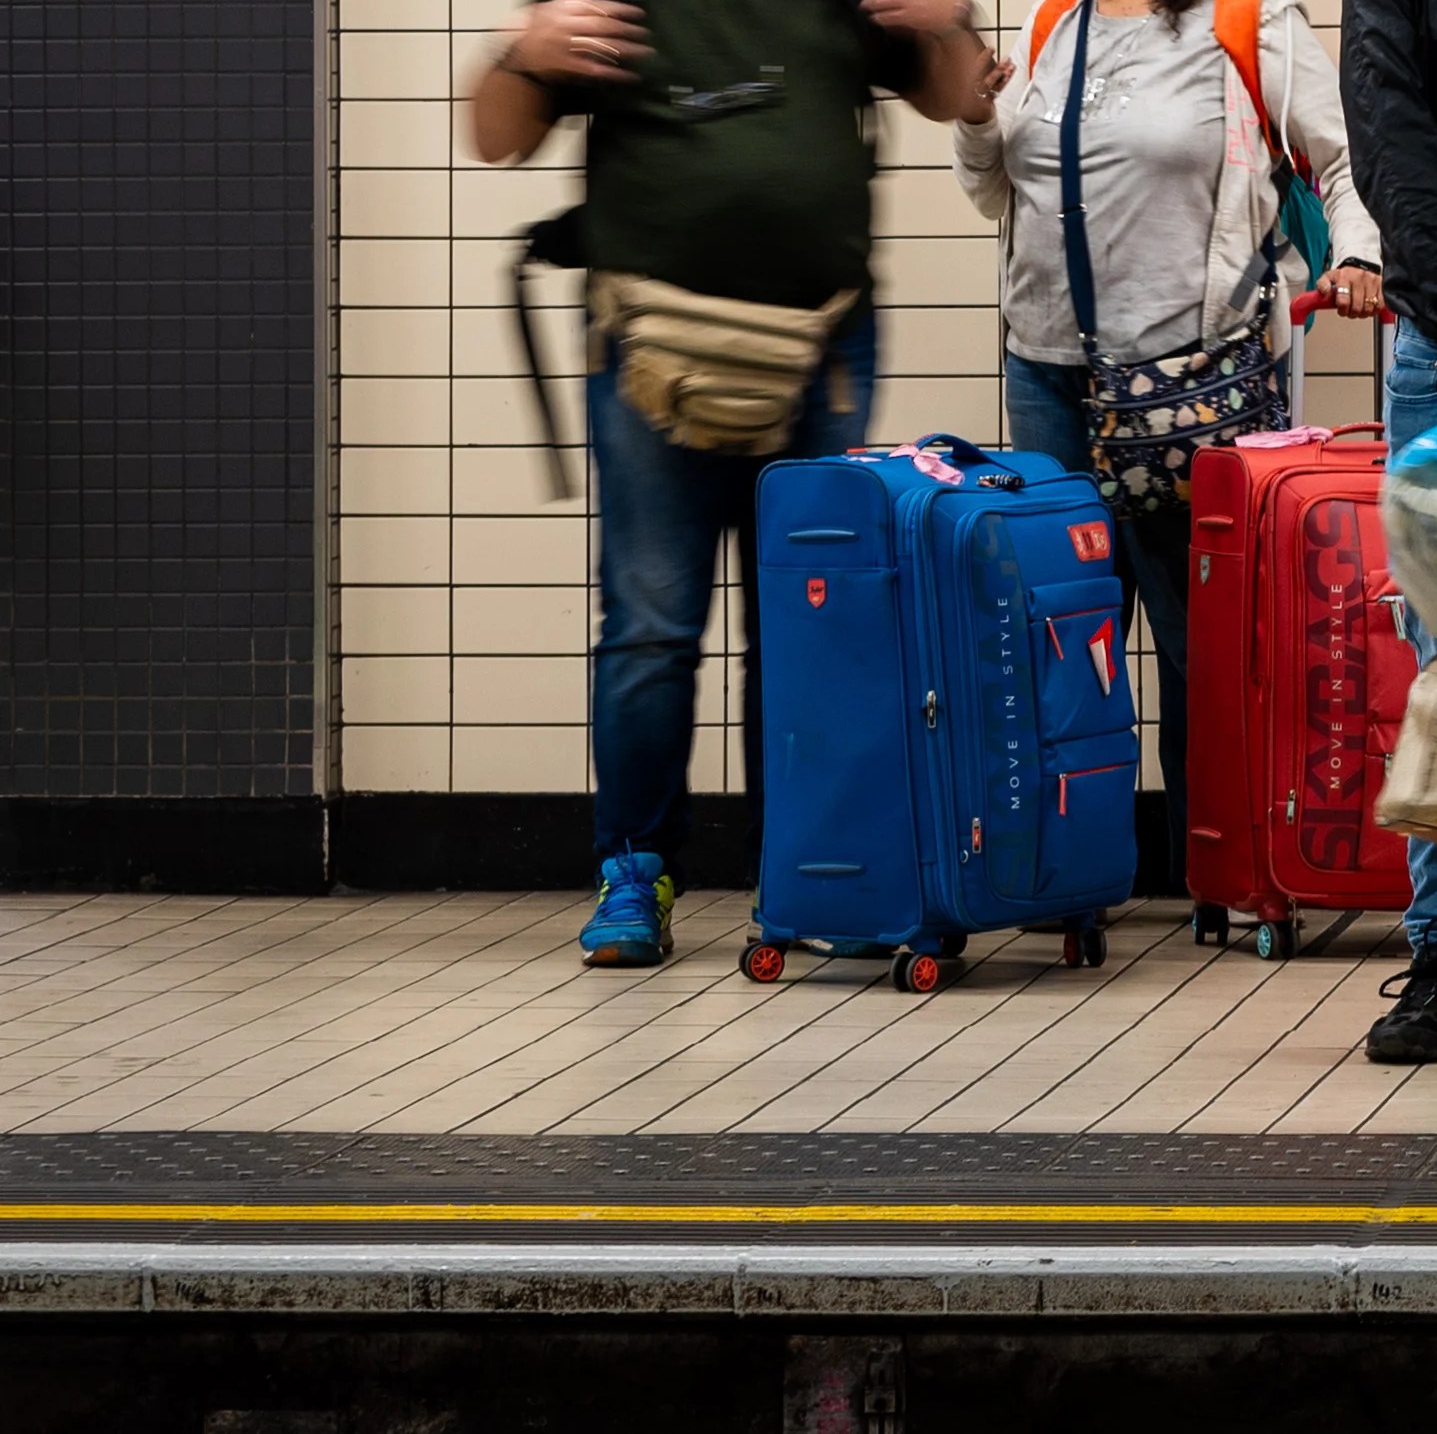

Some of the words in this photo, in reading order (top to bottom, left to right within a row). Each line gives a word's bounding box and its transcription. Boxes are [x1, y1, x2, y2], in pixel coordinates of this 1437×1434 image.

[996, 596, 1015, 676] STYLE
[1329, 583, 1344, 661] STYLE
[1004, 693, 1017, 720] IN
[1305, 501, 1365, 869] SKYBAGS
[1329, 677, 1343, 703] IN
[1006, 738, 1022, 811] MOVE
[1329, 720, 1344, 791] MOVE
